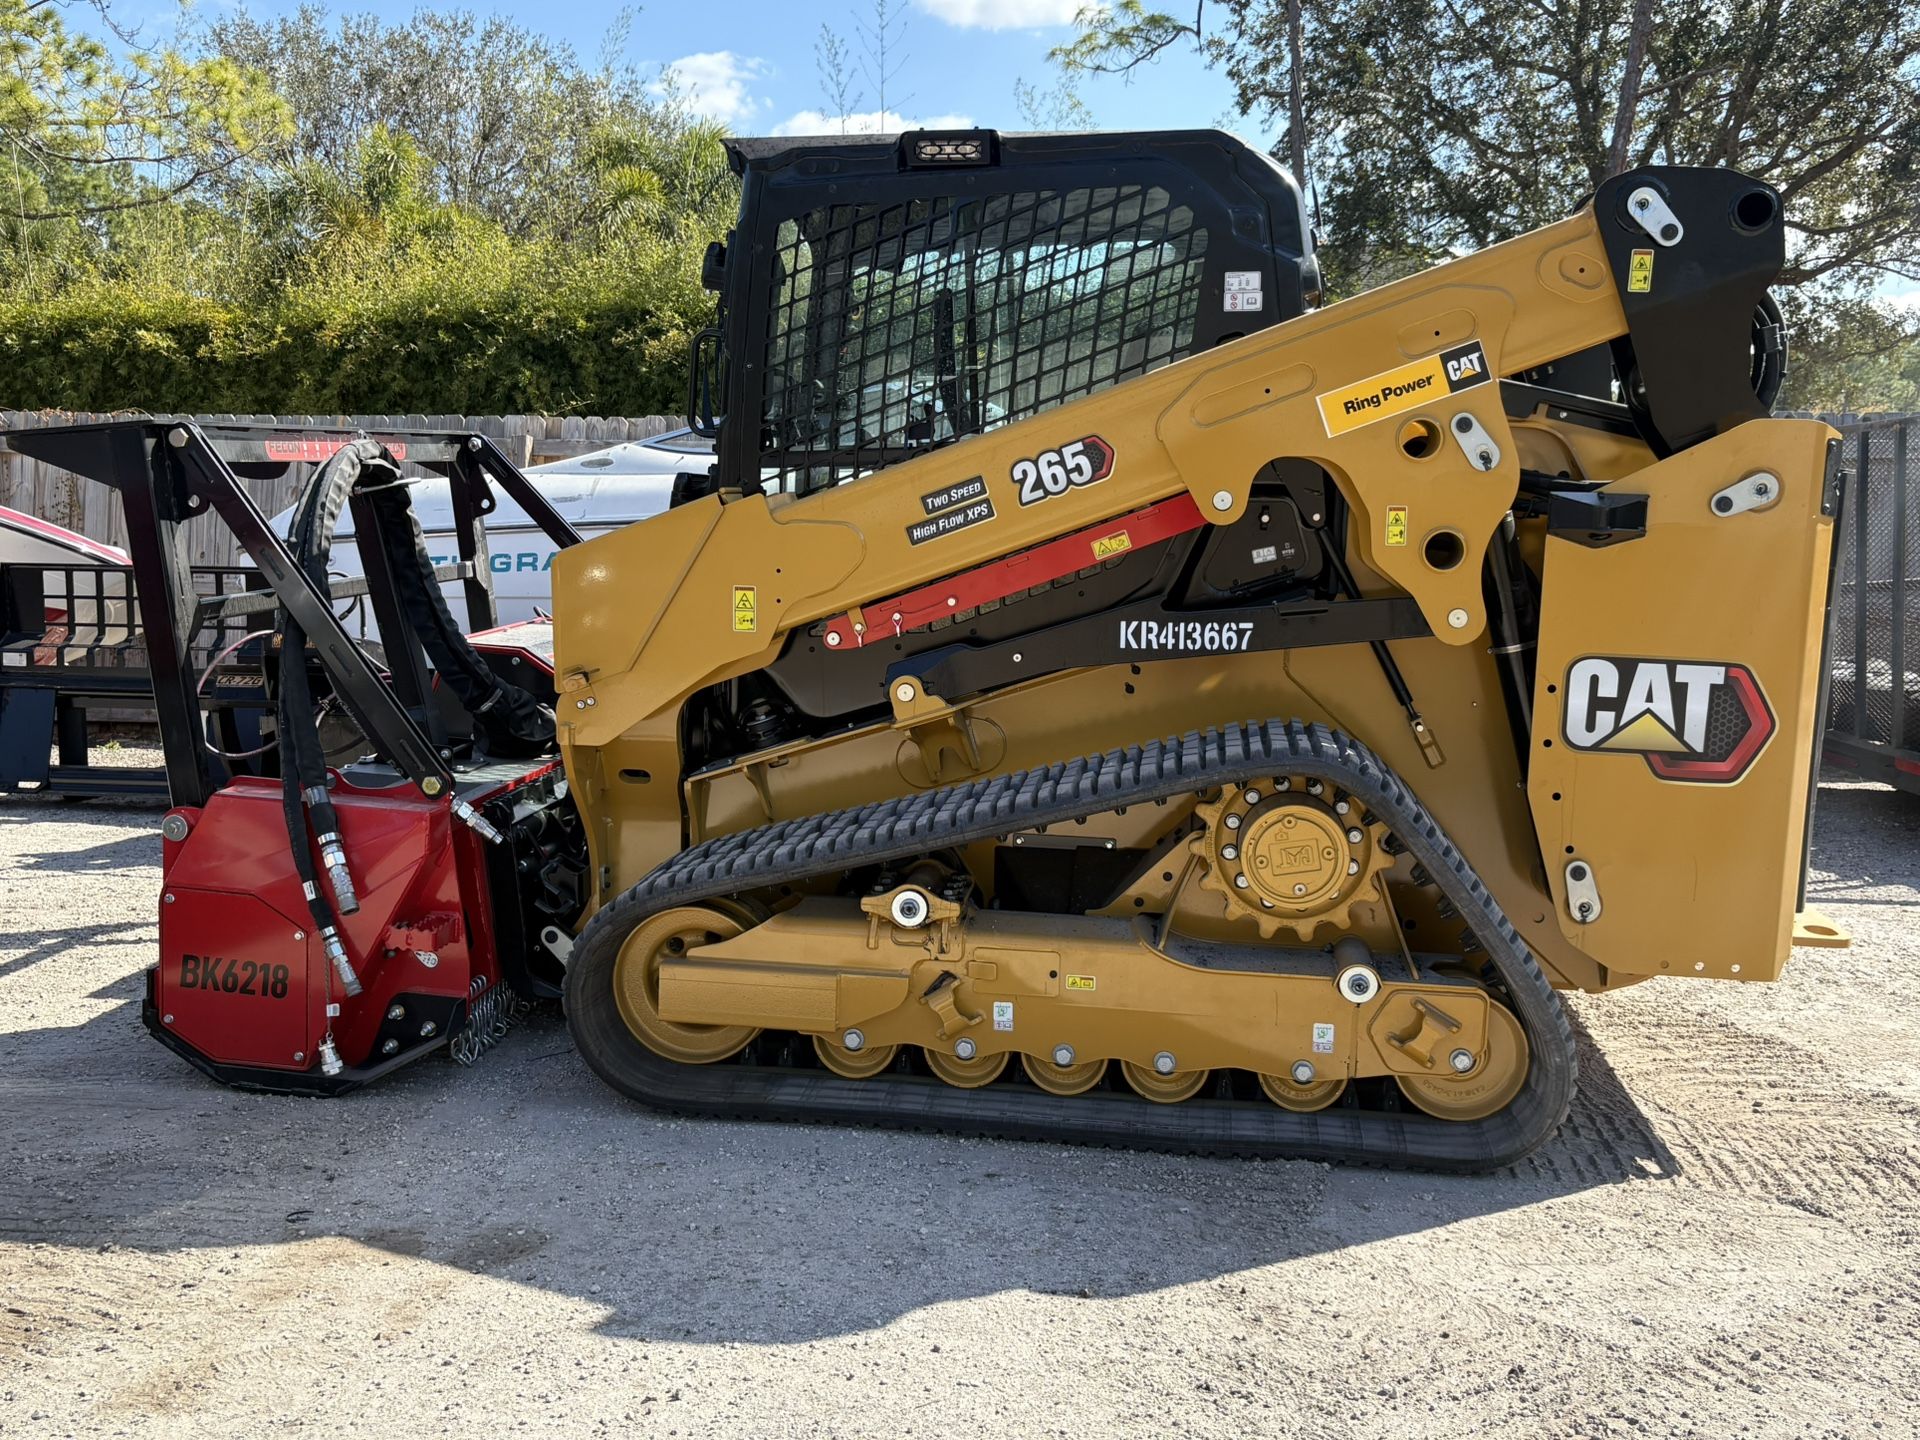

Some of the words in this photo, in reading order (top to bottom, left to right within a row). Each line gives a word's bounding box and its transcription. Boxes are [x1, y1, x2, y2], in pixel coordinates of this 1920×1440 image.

[1446, 352, 1482, 382] CAT
[1343, 394, 1381, 415] Ring
[1381, 375, 1434, 401] Power
[1012, 441, 1092, 503] 265
[967, 504, 988, 520] XPS
[1119, 620, 1254, 650] KR413667
[1565, 658, 1726, 753] CAT
[180, 953, 289, 999] BK6218
